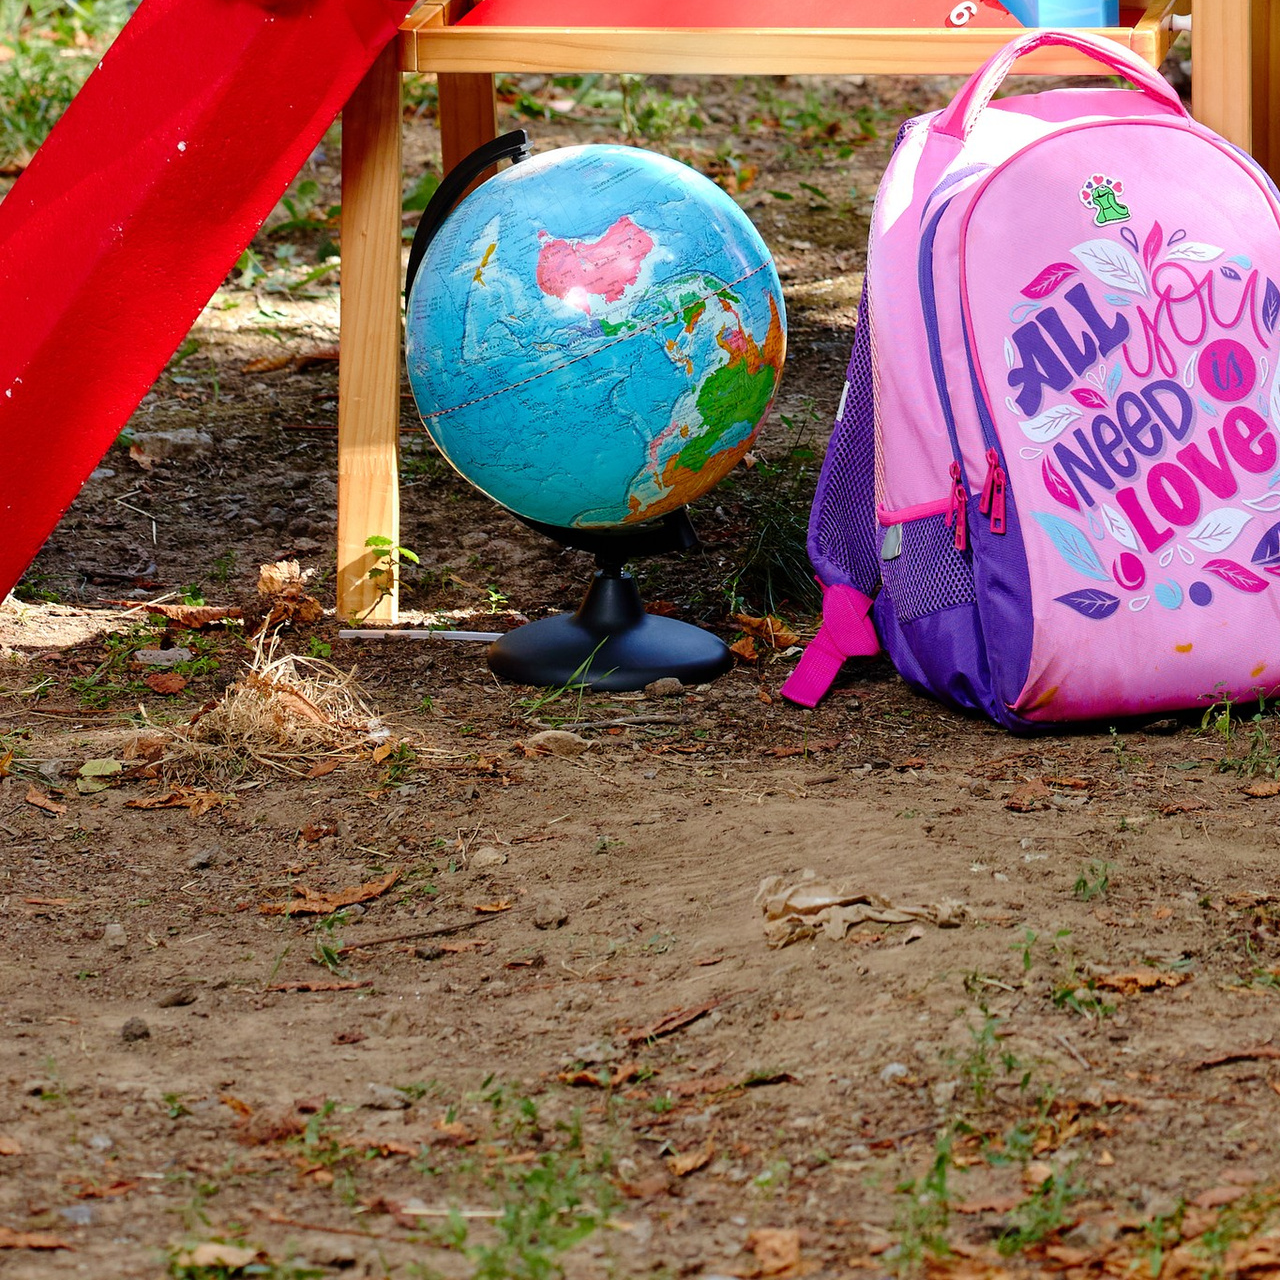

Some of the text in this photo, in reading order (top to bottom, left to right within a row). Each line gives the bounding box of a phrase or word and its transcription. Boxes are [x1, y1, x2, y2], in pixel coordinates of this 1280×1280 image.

[949, 0, 978, 27] 6
[1007, 261, 1270, 417] ALL you
[1210, 350, 1244, 391] is
